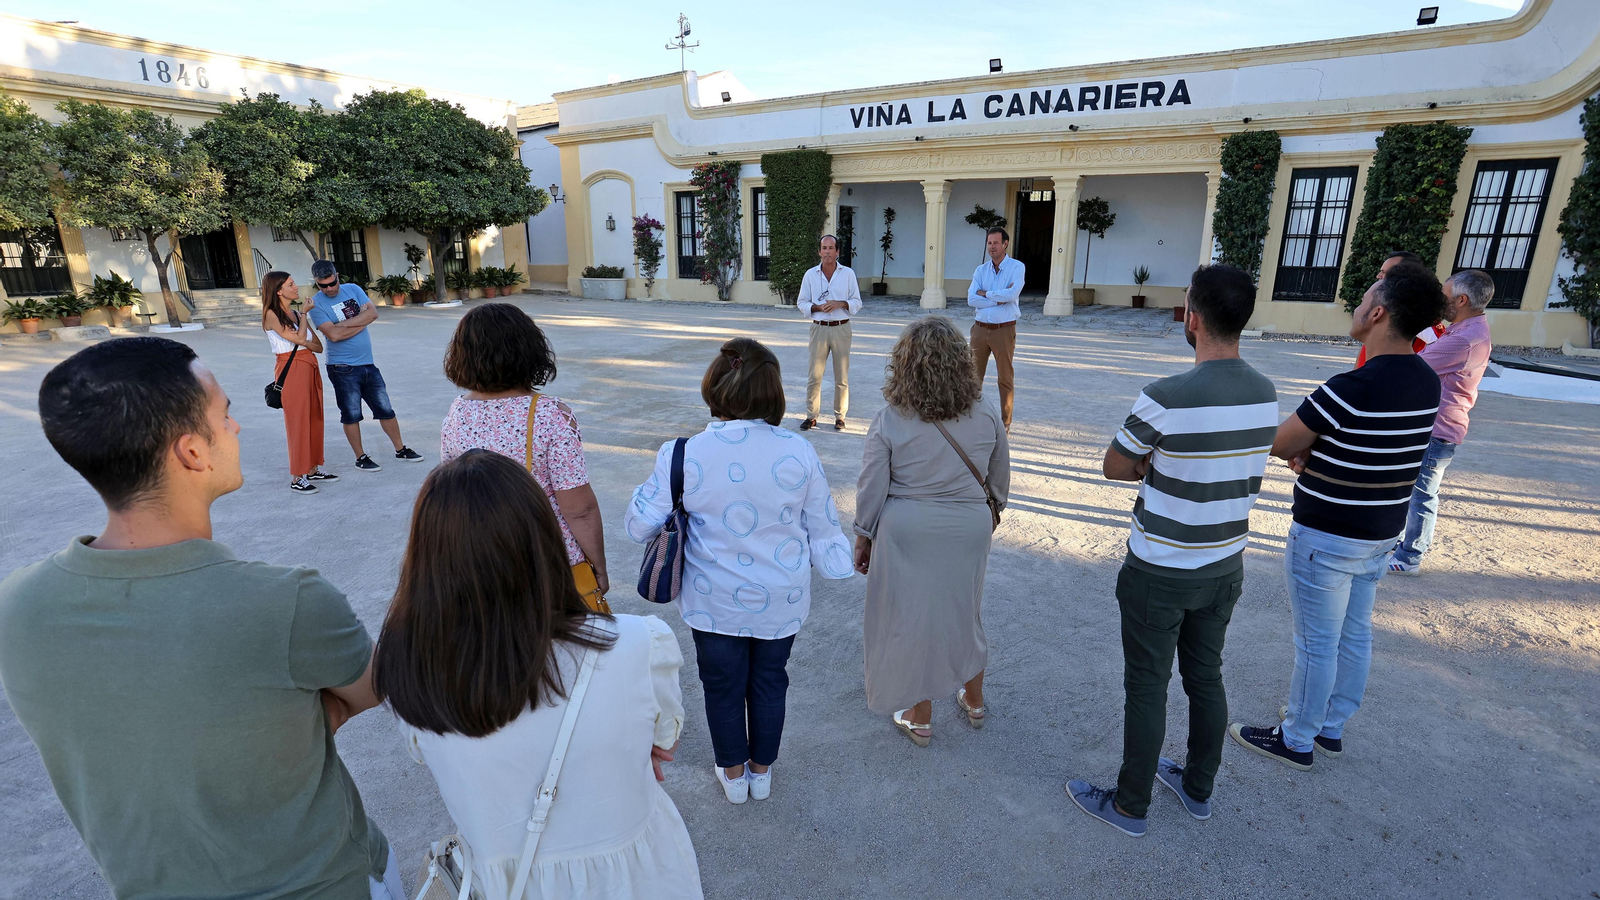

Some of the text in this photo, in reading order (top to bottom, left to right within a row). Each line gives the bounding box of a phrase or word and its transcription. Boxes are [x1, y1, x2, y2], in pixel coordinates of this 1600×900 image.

[138, 58, 209, 89] 1846
[850, 79, 1191, 128] VIÑA LA CANARIERA
